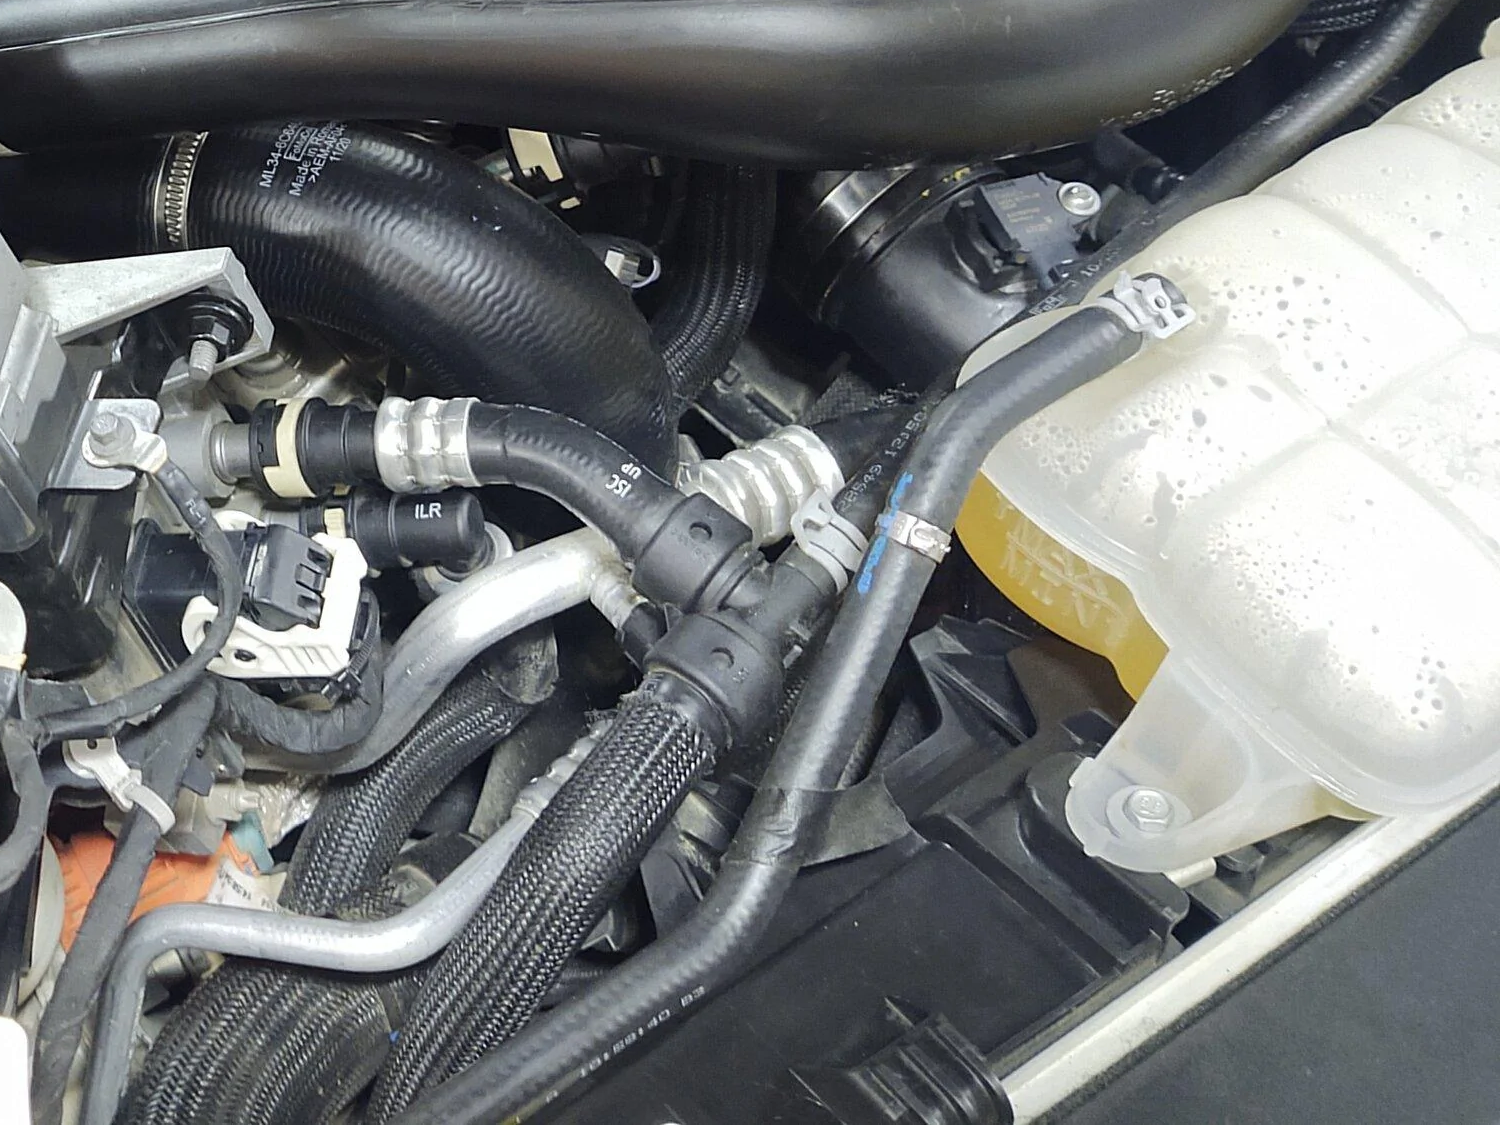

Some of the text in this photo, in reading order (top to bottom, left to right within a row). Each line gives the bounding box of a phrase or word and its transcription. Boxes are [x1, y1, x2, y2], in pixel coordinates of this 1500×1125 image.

[330, 137, 351, 161] 11/20
[289, 159, 311, 196] Made
[620, 462, 641, 479] UP
[605, 473, 632, 497] ISC
[414, 502, 442, 520] ILR
